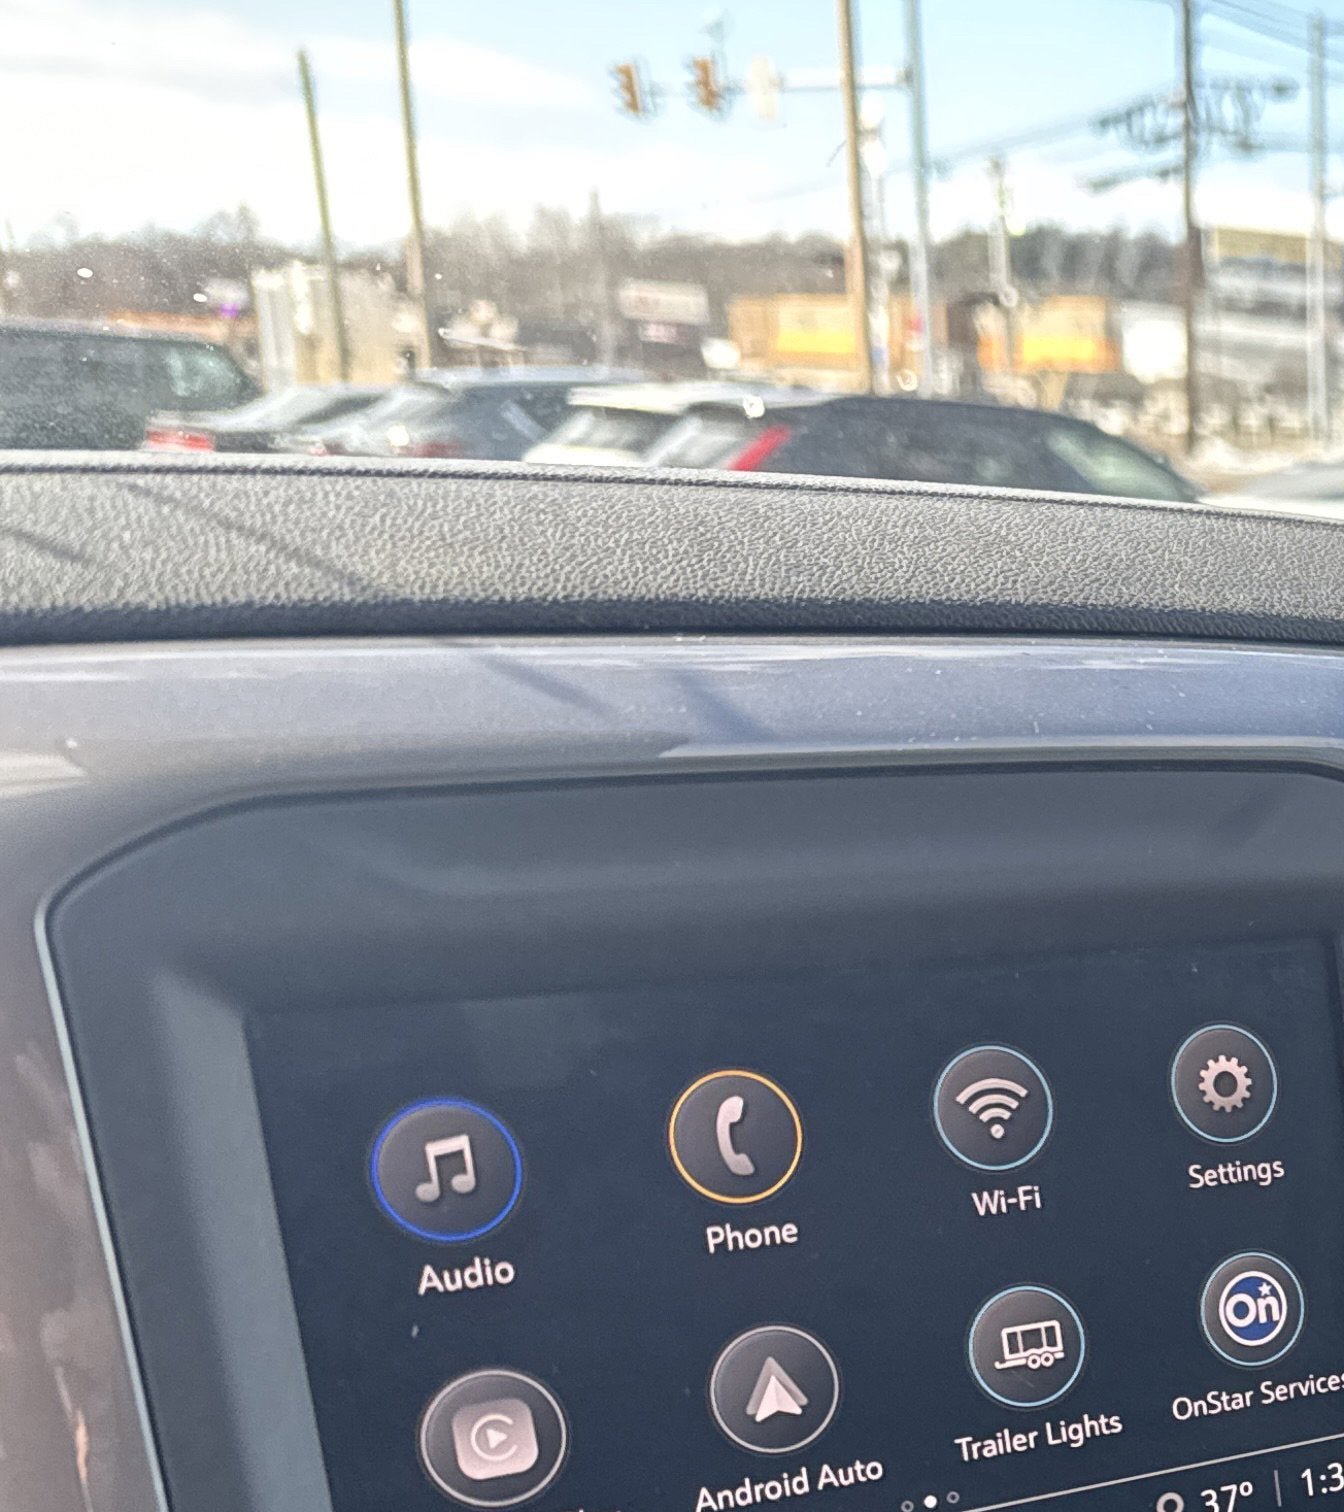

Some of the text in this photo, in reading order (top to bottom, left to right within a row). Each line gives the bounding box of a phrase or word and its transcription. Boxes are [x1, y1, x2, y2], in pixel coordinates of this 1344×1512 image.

[1188, 1160, 1285, 1190] Settings
[972, 1184, 1043, 1217] Wi-Fi
[706, 1221, 798, 1254] Phone
[417, 1257, 516, 1296] Audio
[1224, 1293, 1281, 1328] On
[1172, 1387, 1254, 1421] OnStar
[955, 1412, 1123, 1462] Trailer Lights
[817, 1456, 885, 1491] Auto
